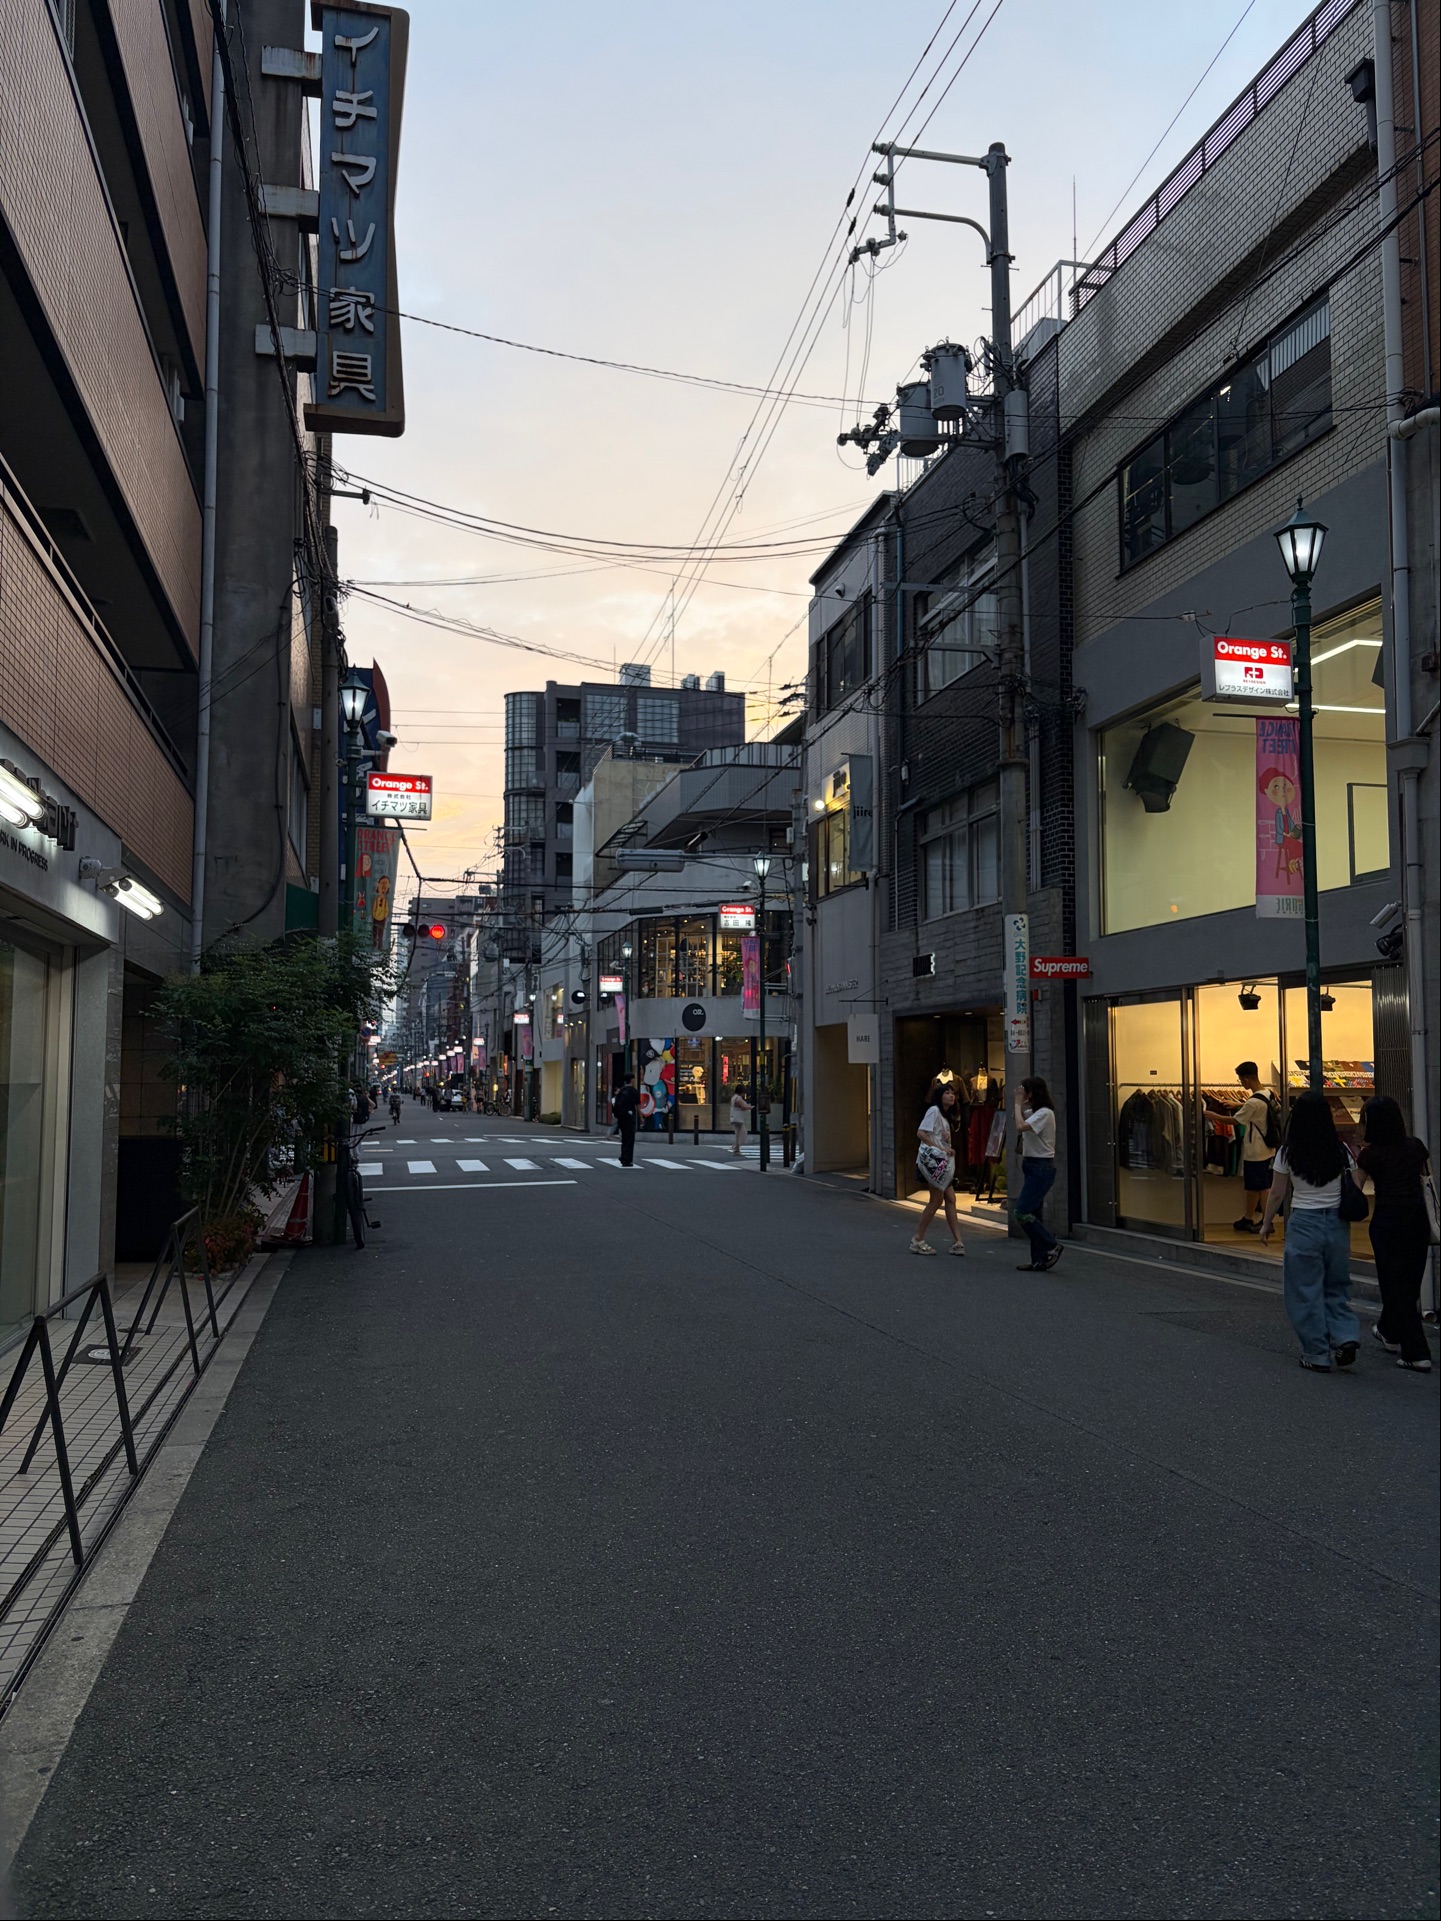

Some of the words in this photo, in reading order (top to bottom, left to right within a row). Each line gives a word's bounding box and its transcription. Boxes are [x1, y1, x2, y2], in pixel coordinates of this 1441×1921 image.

[329, 26, 379, 401] イチマツ家具
[1217, 640, 1267, 660] Orange
[1270, 645, 1287, 659] St.
[372, 778, 413, 791] Orange
[415, 780, 428, 790] St.
[371, 799, 428, 815] イチマツ家具
[18, 841, 49, 873] PROGRESS
[1014, 938, 1028, 1015] 大野記念病院
[1033, 958, 1088, 976] Supreme
[855, 1034, 871, 1043] HARE
